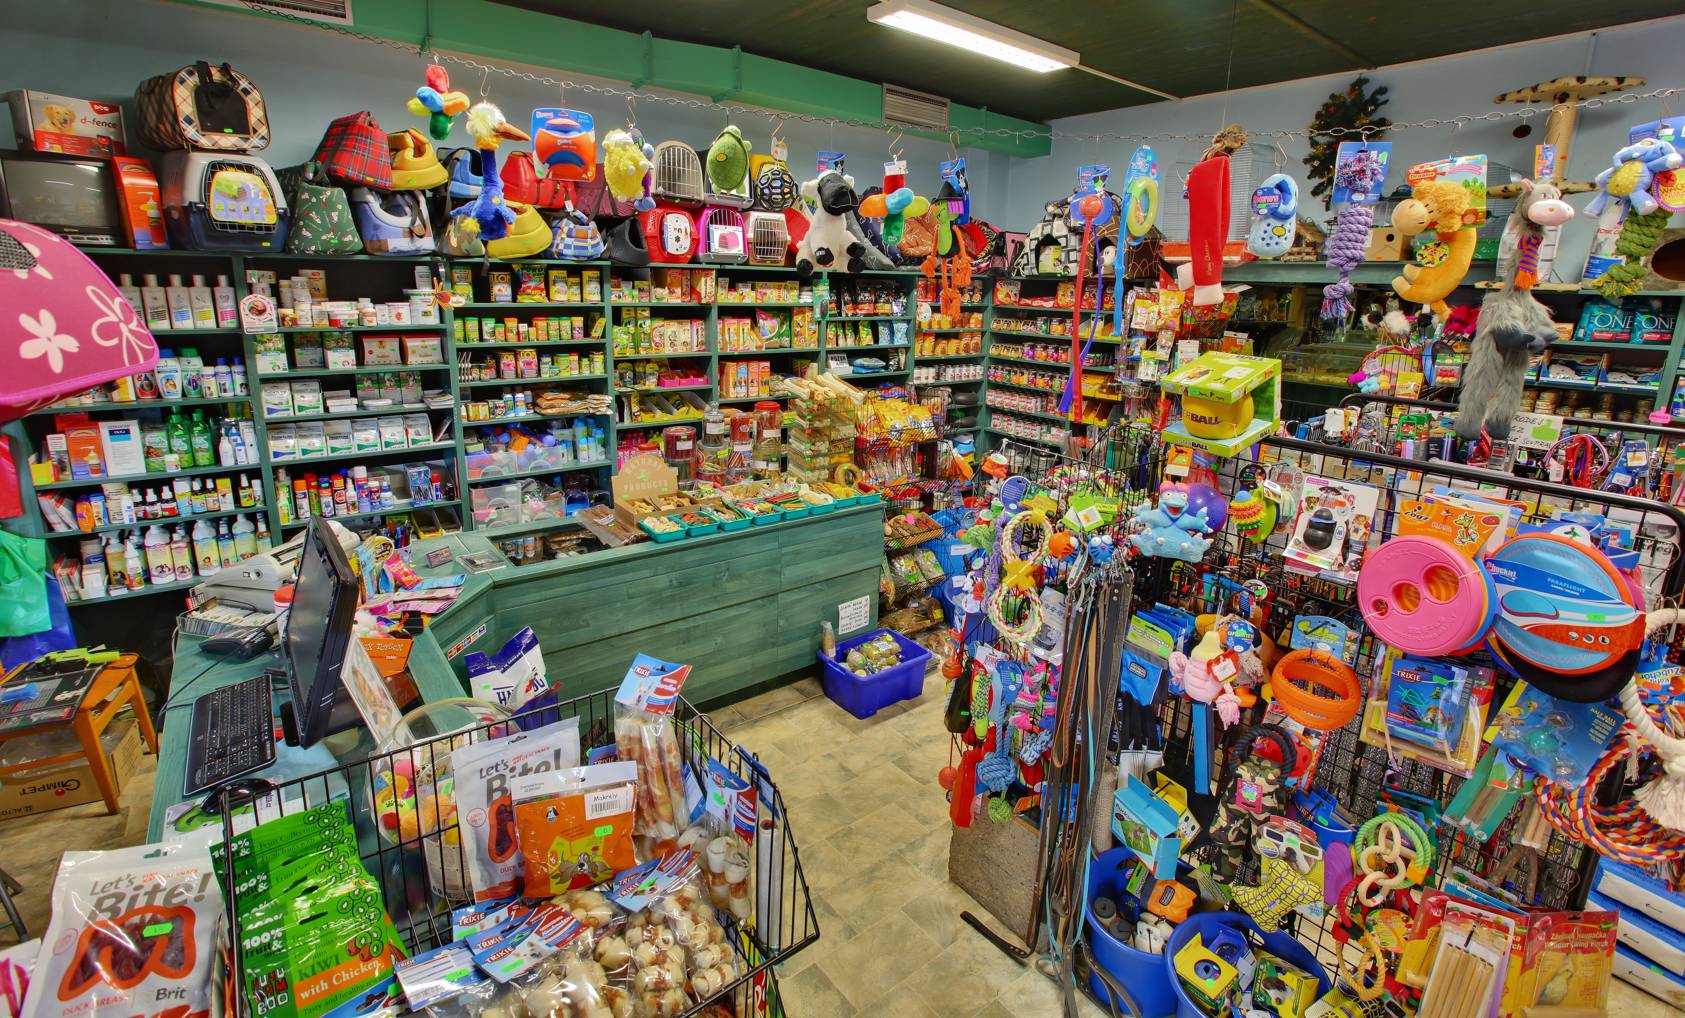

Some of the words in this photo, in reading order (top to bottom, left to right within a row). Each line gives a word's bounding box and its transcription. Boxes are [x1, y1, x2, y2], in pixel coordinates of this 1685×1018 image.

[80, 116, 119, 129] d-fence
[1486, 562, 1517, 580] Chuckit!
[1396, 670, 1421, 682] TRIXIE
[479, 759, 509, 780] Let's
[89, 873, 136, 896] Let's
[235, 873, 268, 896] 100%
[85, 872, 214, 926] Bite!
[458, 912, 487, 926] TRIXIE
[243, 928, 284, 951] 100%
[476, 936, 505, 950] TRIXIE
[485, 946, 515, 964] TRIXIE
[300, 953, 342, 980] KIWI
[155, 986, 186, 1002] Brit
[300, 980, 330, 1001] with
